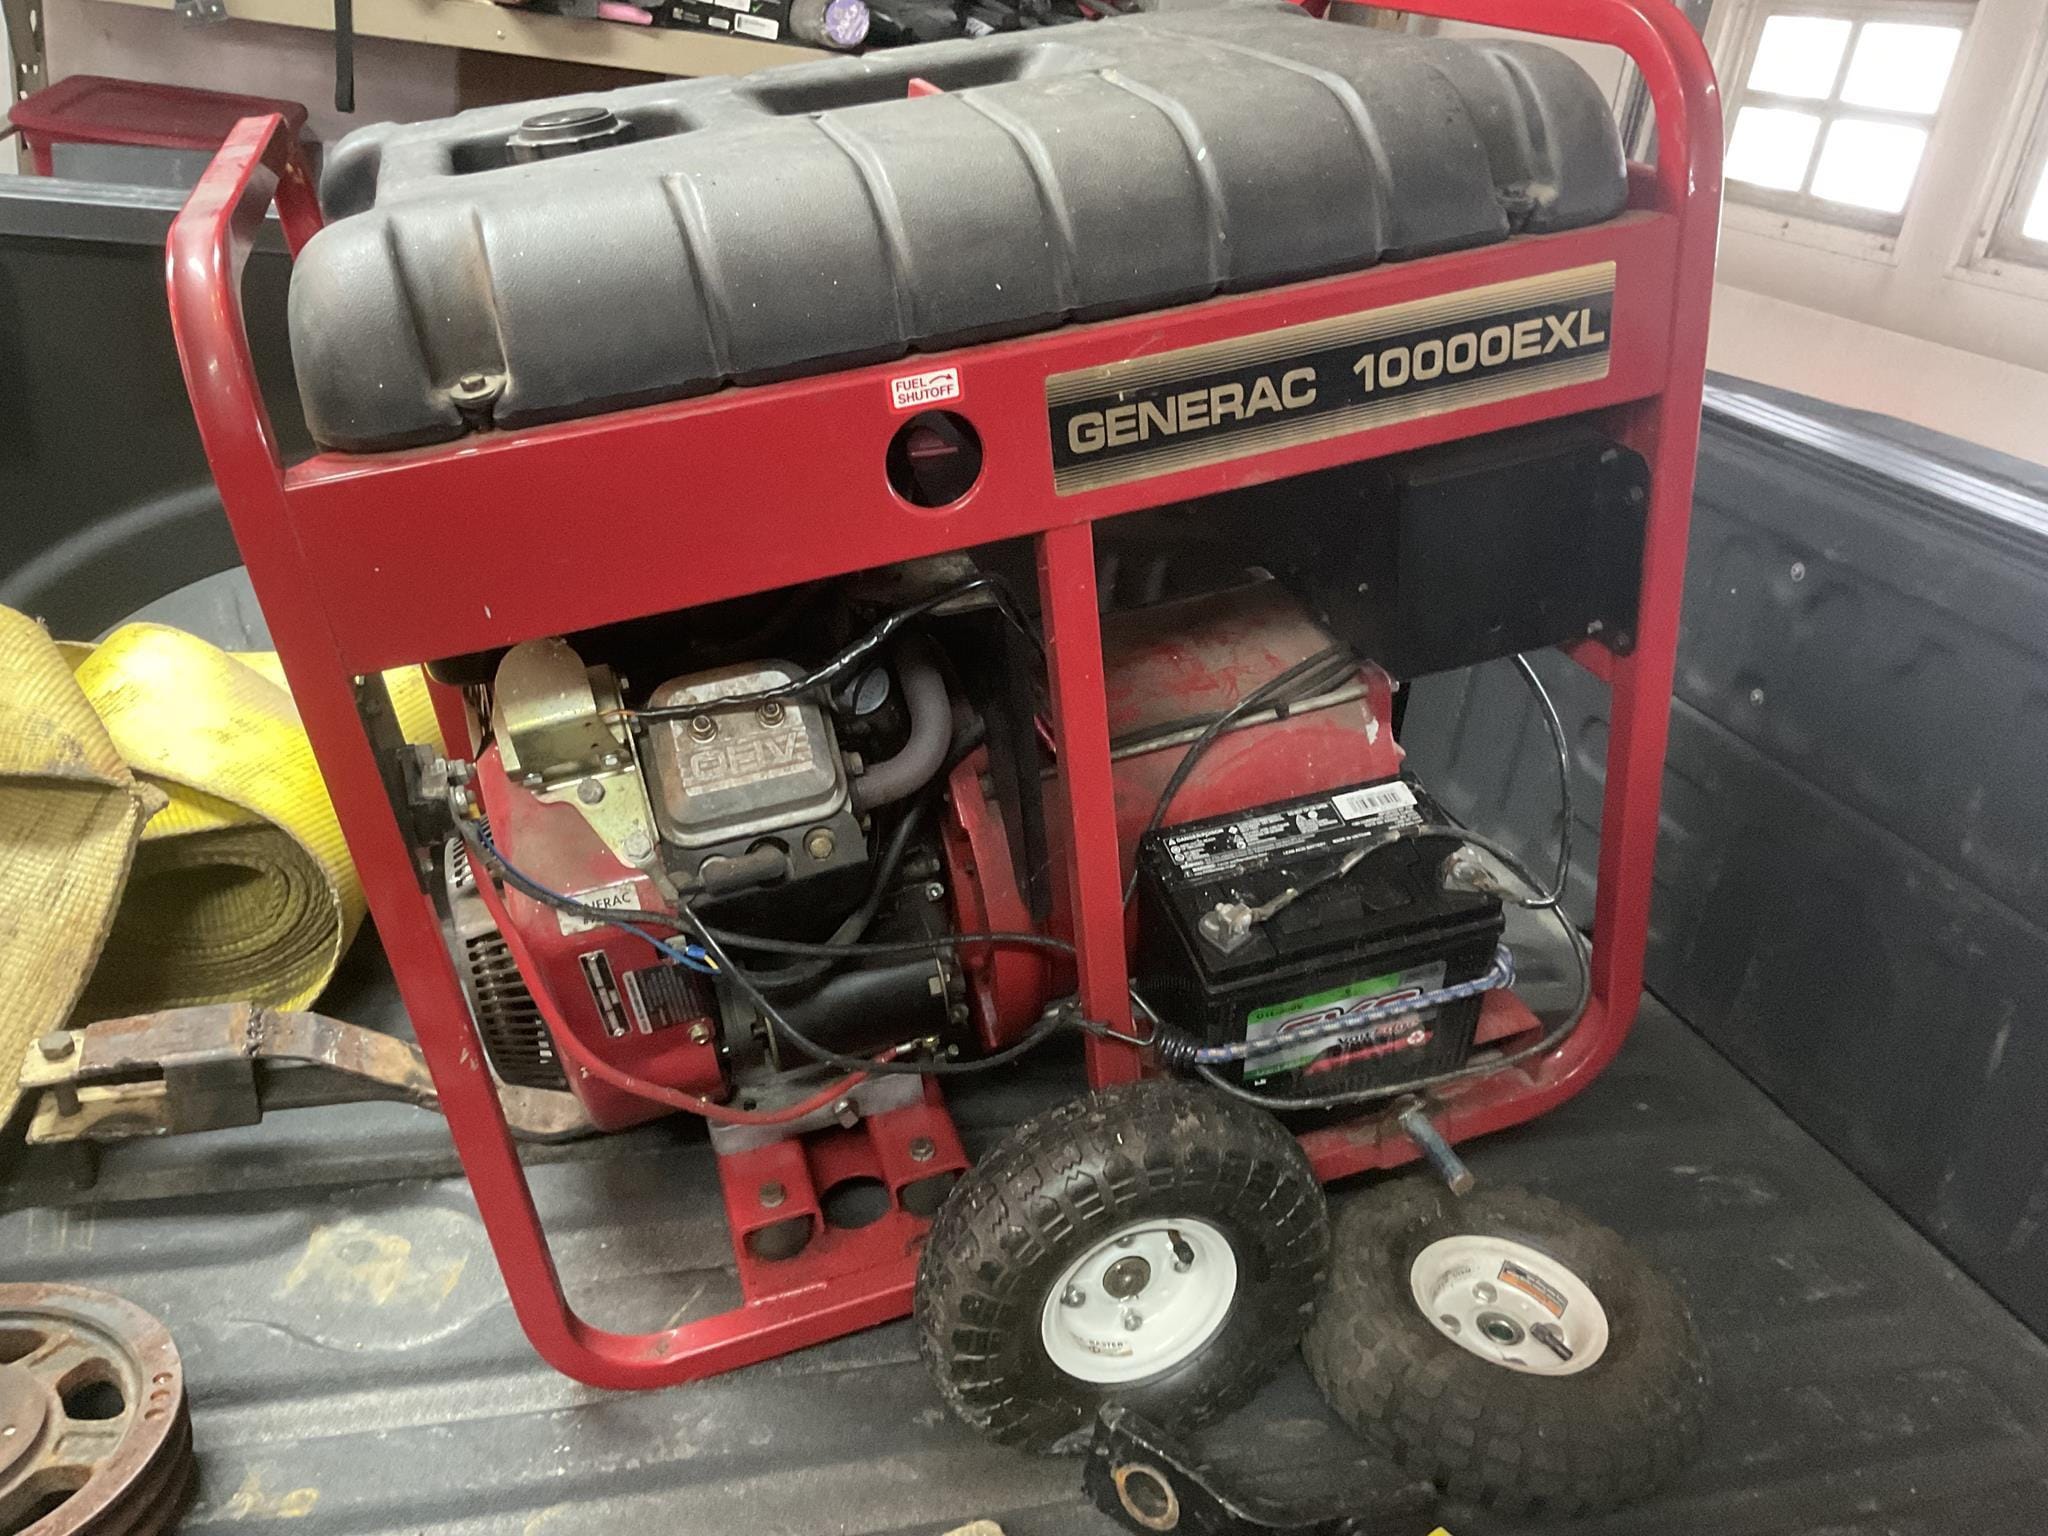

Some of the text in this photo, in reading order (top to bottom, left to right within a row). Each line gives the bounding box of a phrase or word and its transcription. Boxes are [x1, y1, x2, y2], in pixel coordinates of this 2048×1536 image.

[895, 377, 927, 392] FUEL
[1068, 308, 1606, 454] GENERAC 10000EXL
[897, 383, 954, 404] SHUTOFF
